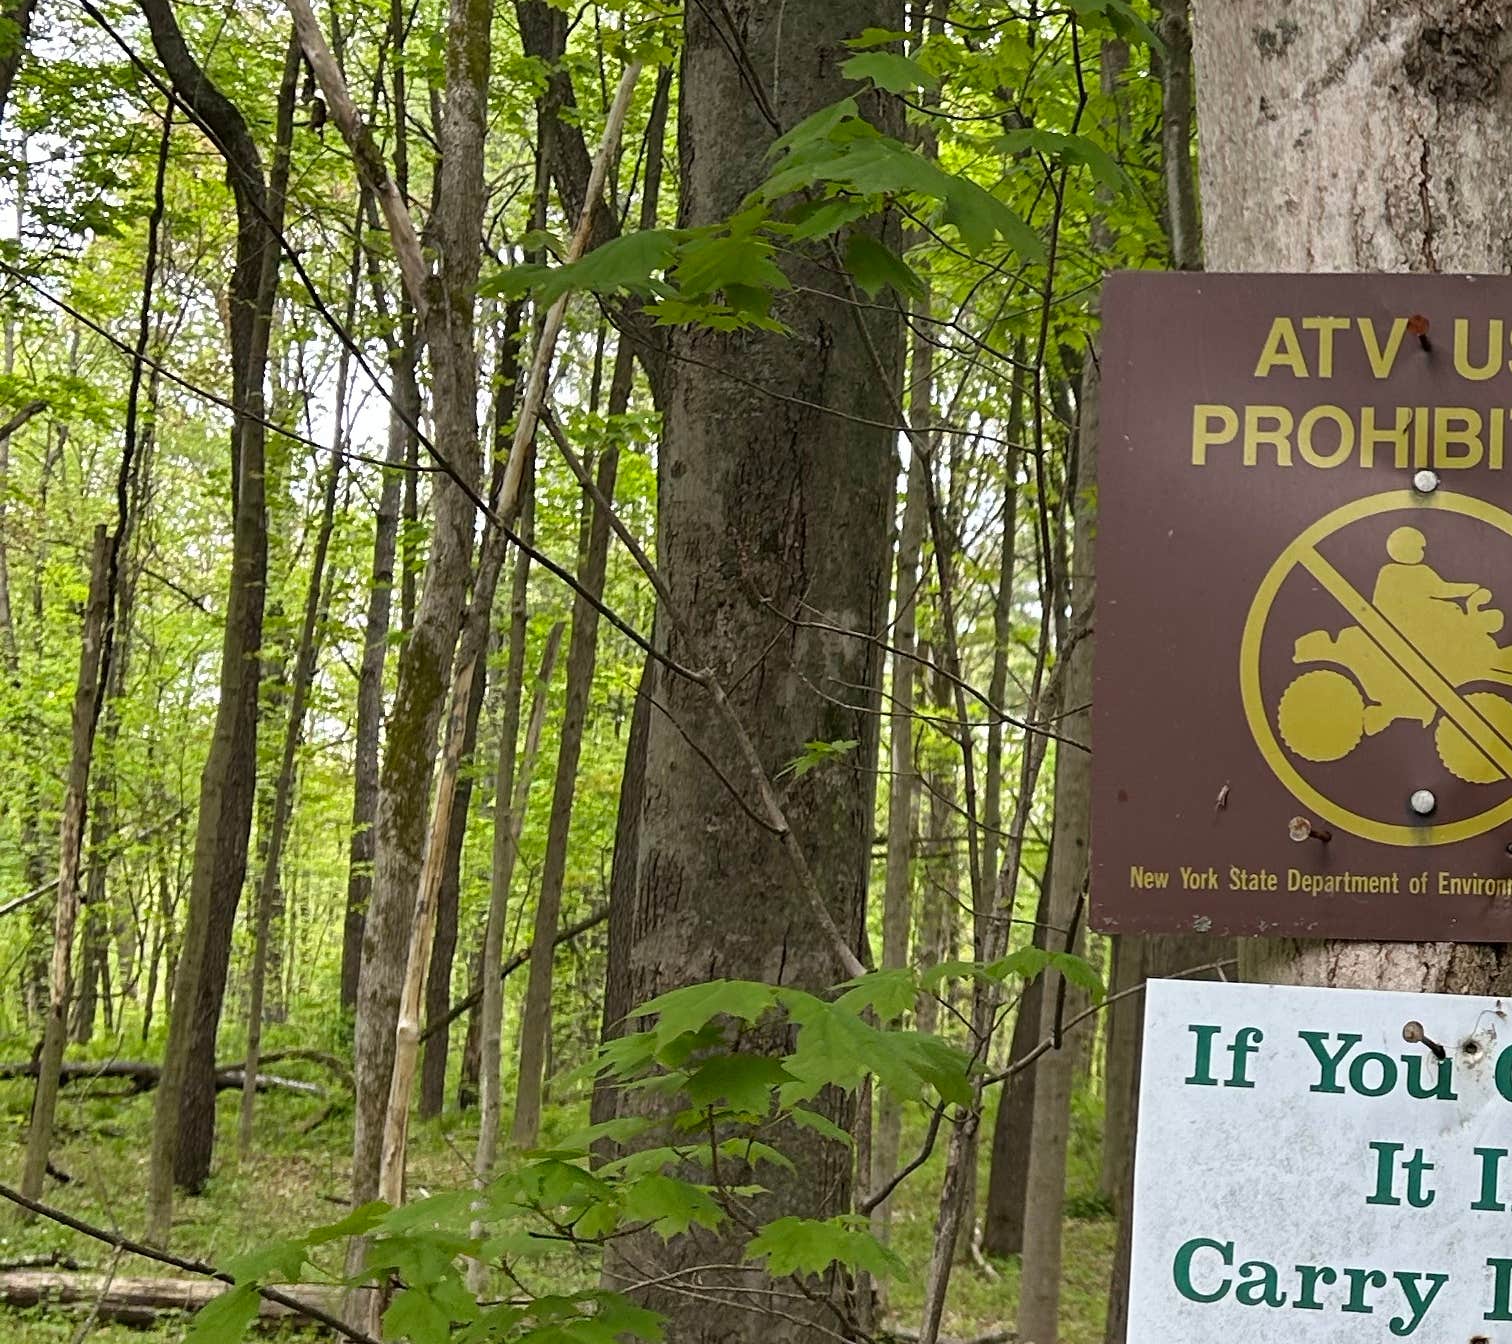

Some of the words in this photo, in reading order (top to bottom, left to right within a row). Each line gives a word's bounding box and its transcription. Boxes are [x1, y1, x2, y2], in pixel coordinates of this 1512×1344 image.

[1254, 316, 1410, 379] ATV
[1129, 866, 1169, 889] New
[1179, 867, 1219, 890] York
[1229, 865, 1278, 892] State
[1287, 868, 1400, 897] Department
[1408, 871, 1428, 895] of
[1183, 1024, 1264, 1088] If
[1297, 1030, 1459, 1102] You
[1365, 1141, 1436, 1209] It
[1171, 1237, 1450, 1337] Carry
